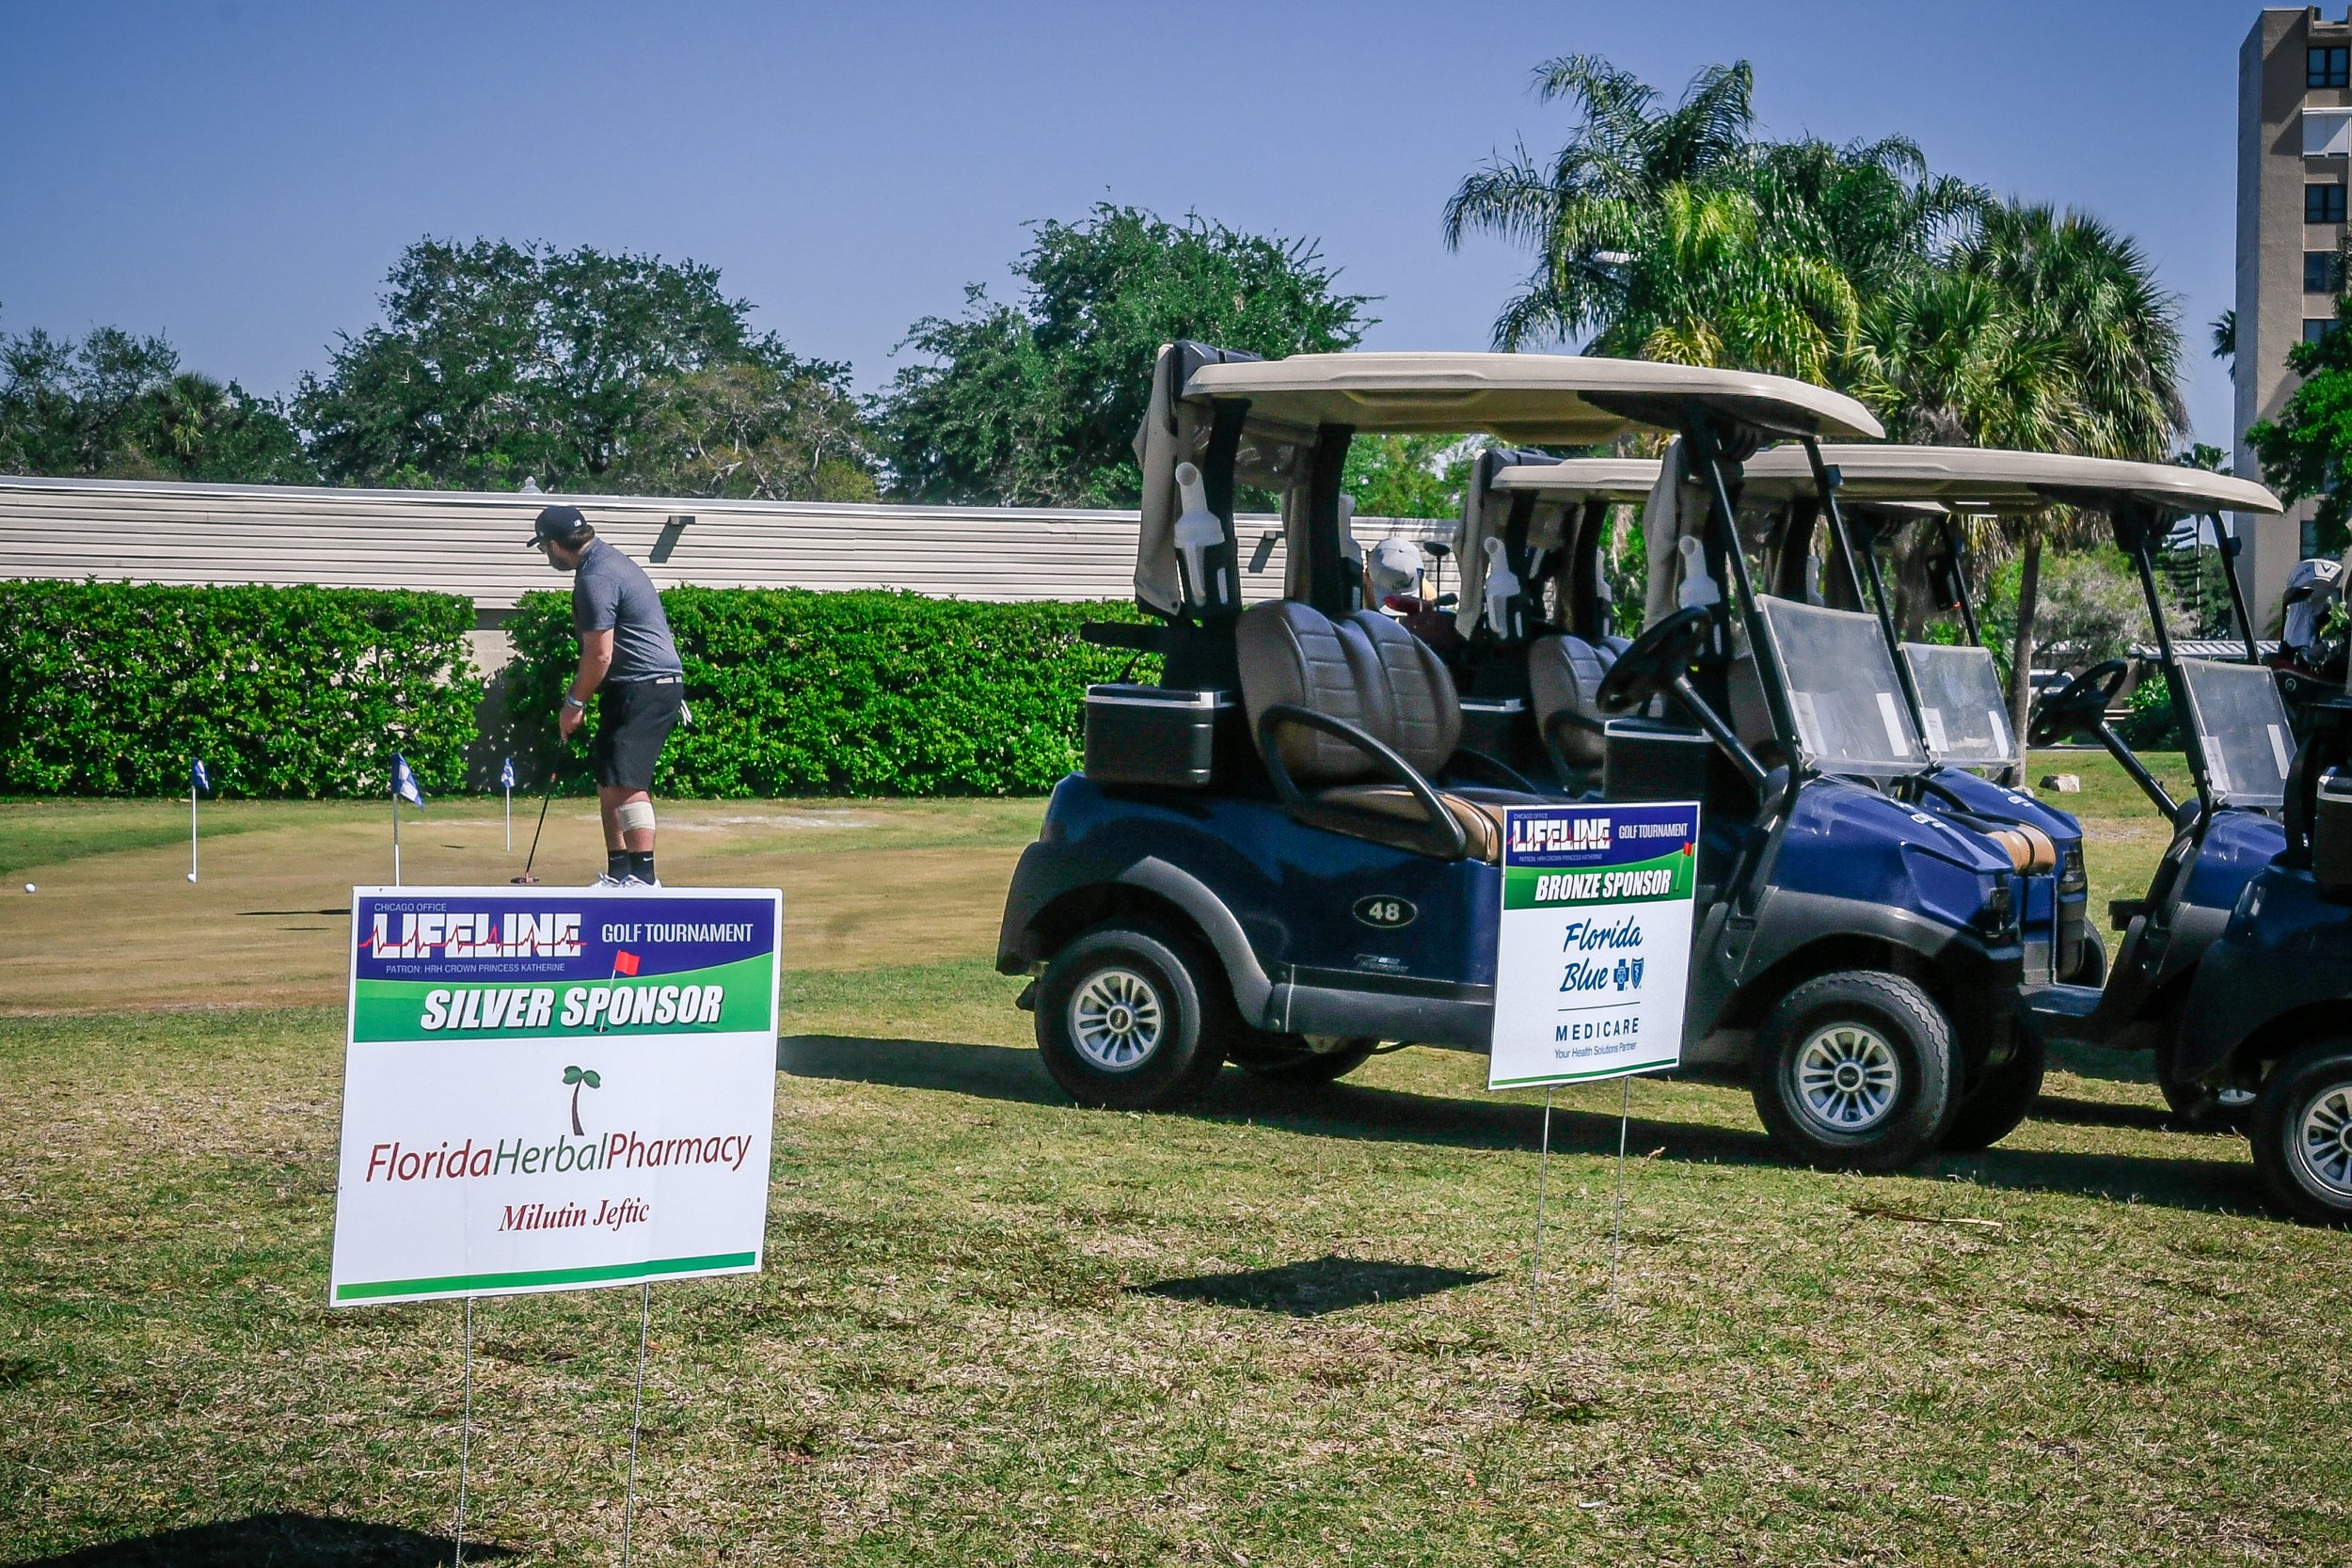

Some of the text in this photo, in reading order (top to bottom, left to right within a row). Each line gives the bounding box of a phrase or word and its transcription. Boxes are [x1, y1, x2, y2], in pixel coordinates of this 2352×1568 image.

[1512, 818, 1611, 852] LIFELINE
[1618, 823, 1688, 839] GOLF TOURNAMENT
[1534, 869, 1672, 901] BRONZE SPONSOR
[373, 903, 448, 912] CHICAGO OFFICE
[1369, 902, 1400, 921] 48
[373, 913, 582, 958] LIFELINE
[601, 923, 755, 943] GOLF TOURNAMENT
[1563, 914, 1644, 953] Florida
[386, 962, 565, 974] PATRON: HRH CROWN PRINCESS KATHERINE
[1559, 957, 1609, 992] Blue
[420, 985, 724, 1030] SILVER SPONSOR
[1555, 1017, 1640, 1042] MEDICARE
[1554, 1042, 1637, 1059] Your Health Solutions Partner
[365, 1130, 753, 1183] FloridaHerbalPharmacy
[497, 1196, 651, 1232] Milutin Jeftic
